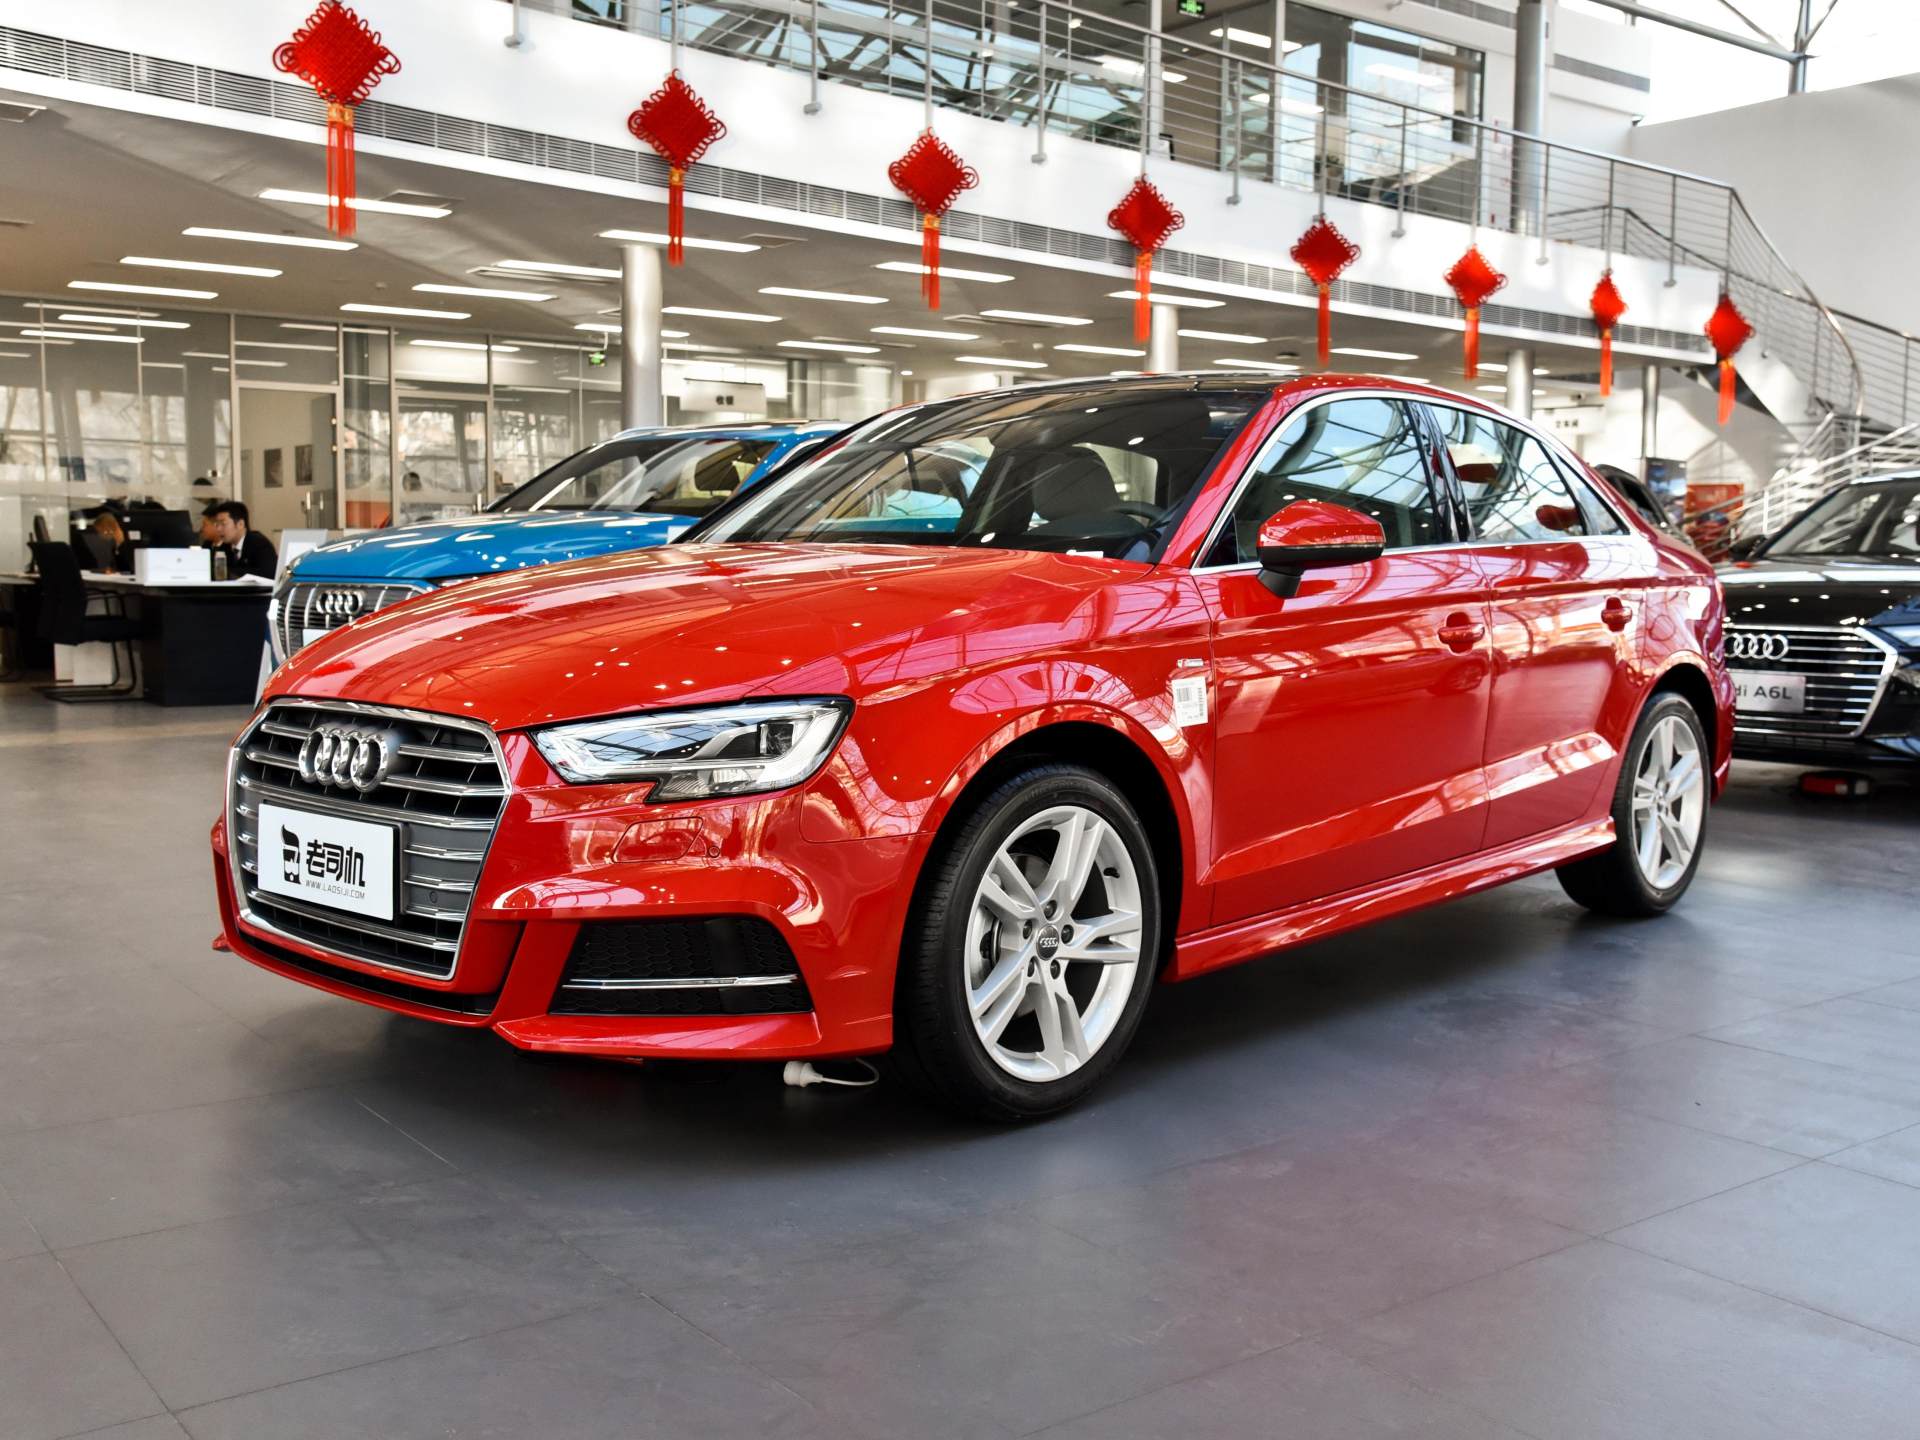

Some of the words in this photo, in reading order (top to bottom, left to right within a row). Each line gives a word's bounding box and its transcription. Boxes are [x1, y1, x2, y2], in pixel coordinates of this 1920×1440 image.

[1753, 685, 1793, 700] A6L
[306, 839, 366, 888] 老司机
[305, 879, 366, 900] WWW.LAOSIJI.COM
